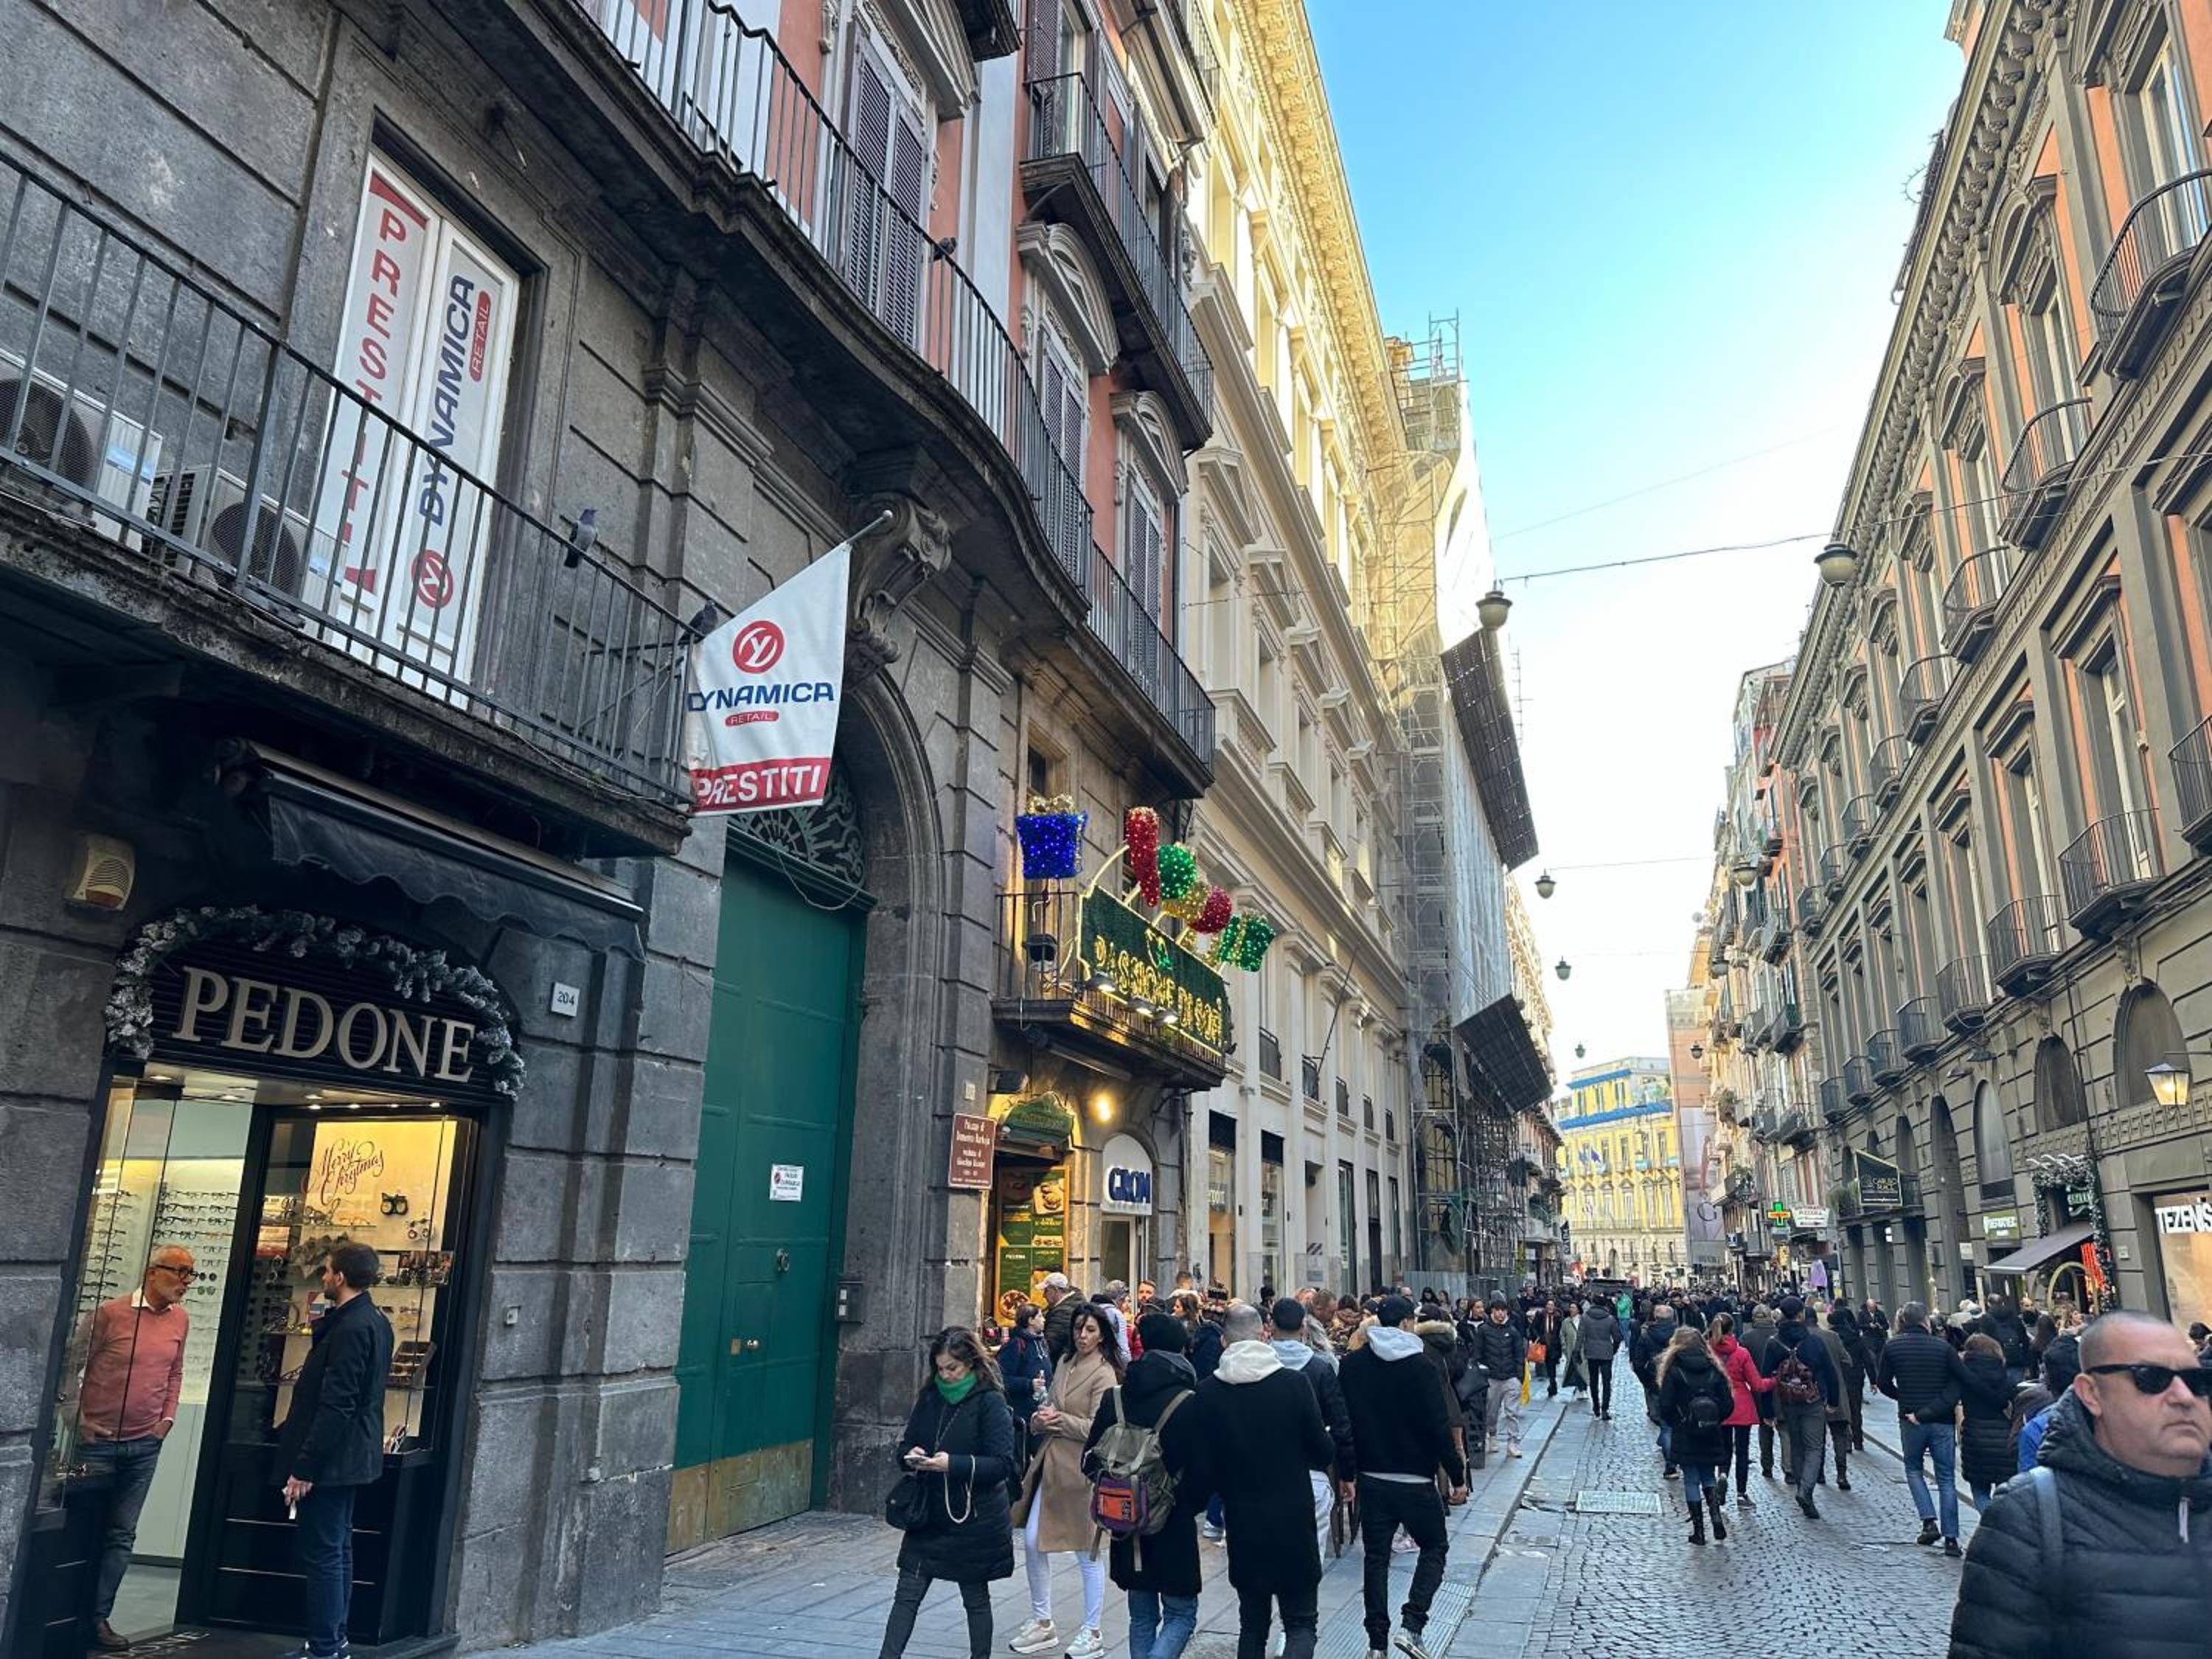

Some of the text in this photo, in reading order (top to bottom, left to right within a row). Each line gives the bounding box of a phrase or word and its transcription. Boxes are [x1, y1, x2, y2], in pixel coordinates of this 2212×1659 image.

[470, 303, 490, 373] RETAIL
[687, 682, 835, 712] DYNAMICA
[730, 712, 773, 725] RETAIL
[696, 765, 821, 805] PRESTITI
[557, 990, 576, 1007] 204
[171, 966, 476, 1084] PEDONE
[2154, 1203, 2212, 1234] TEZENIS
